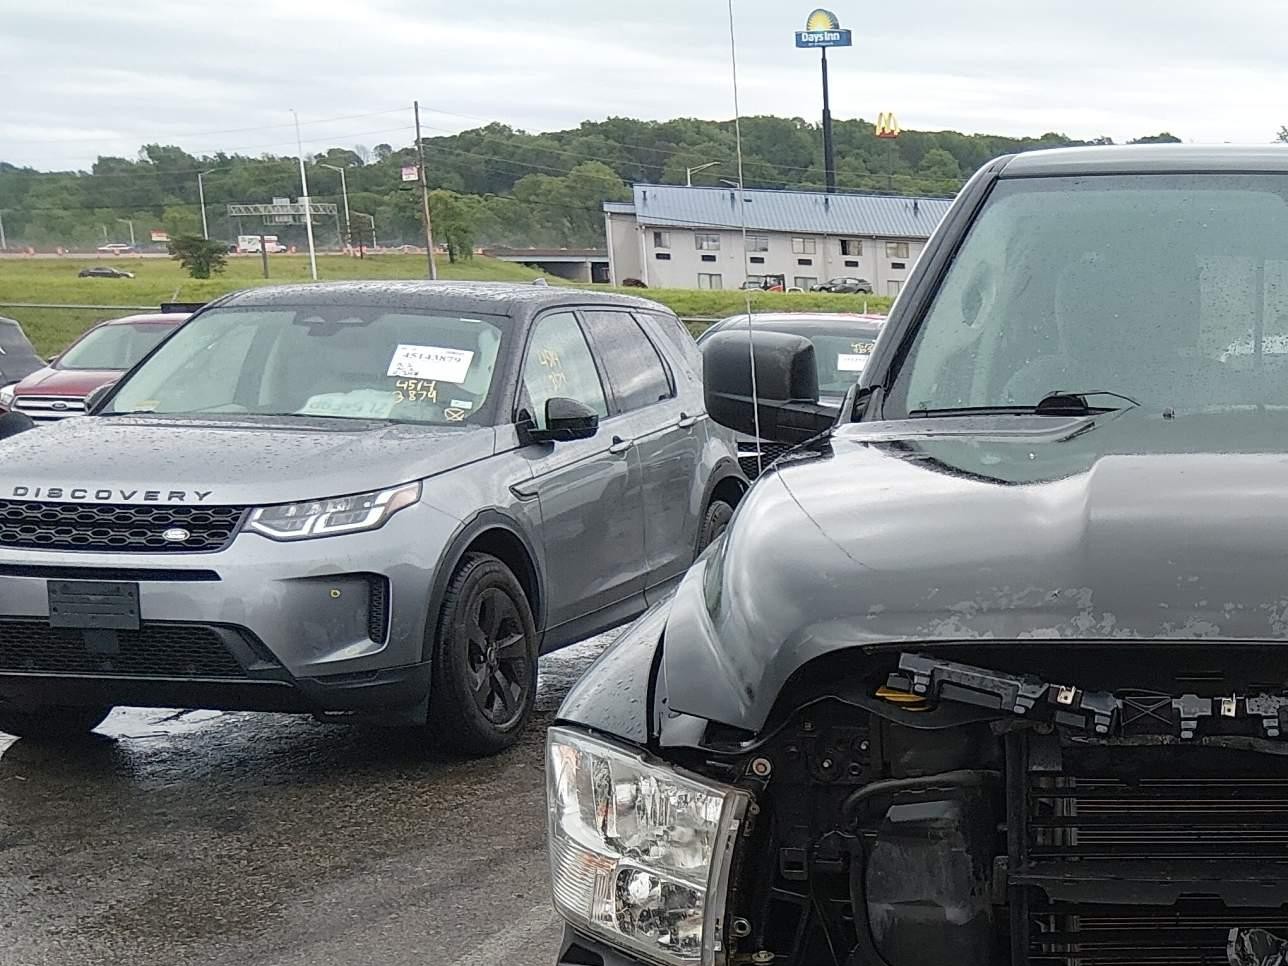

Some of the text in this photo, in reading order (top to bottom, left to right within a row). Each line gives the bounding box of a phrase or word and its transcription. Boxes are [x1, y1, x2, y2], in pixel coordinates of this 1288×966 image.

[802, 31, 840, 42] Days Inn
[13, 486, 213, 502] DISCOVERY
